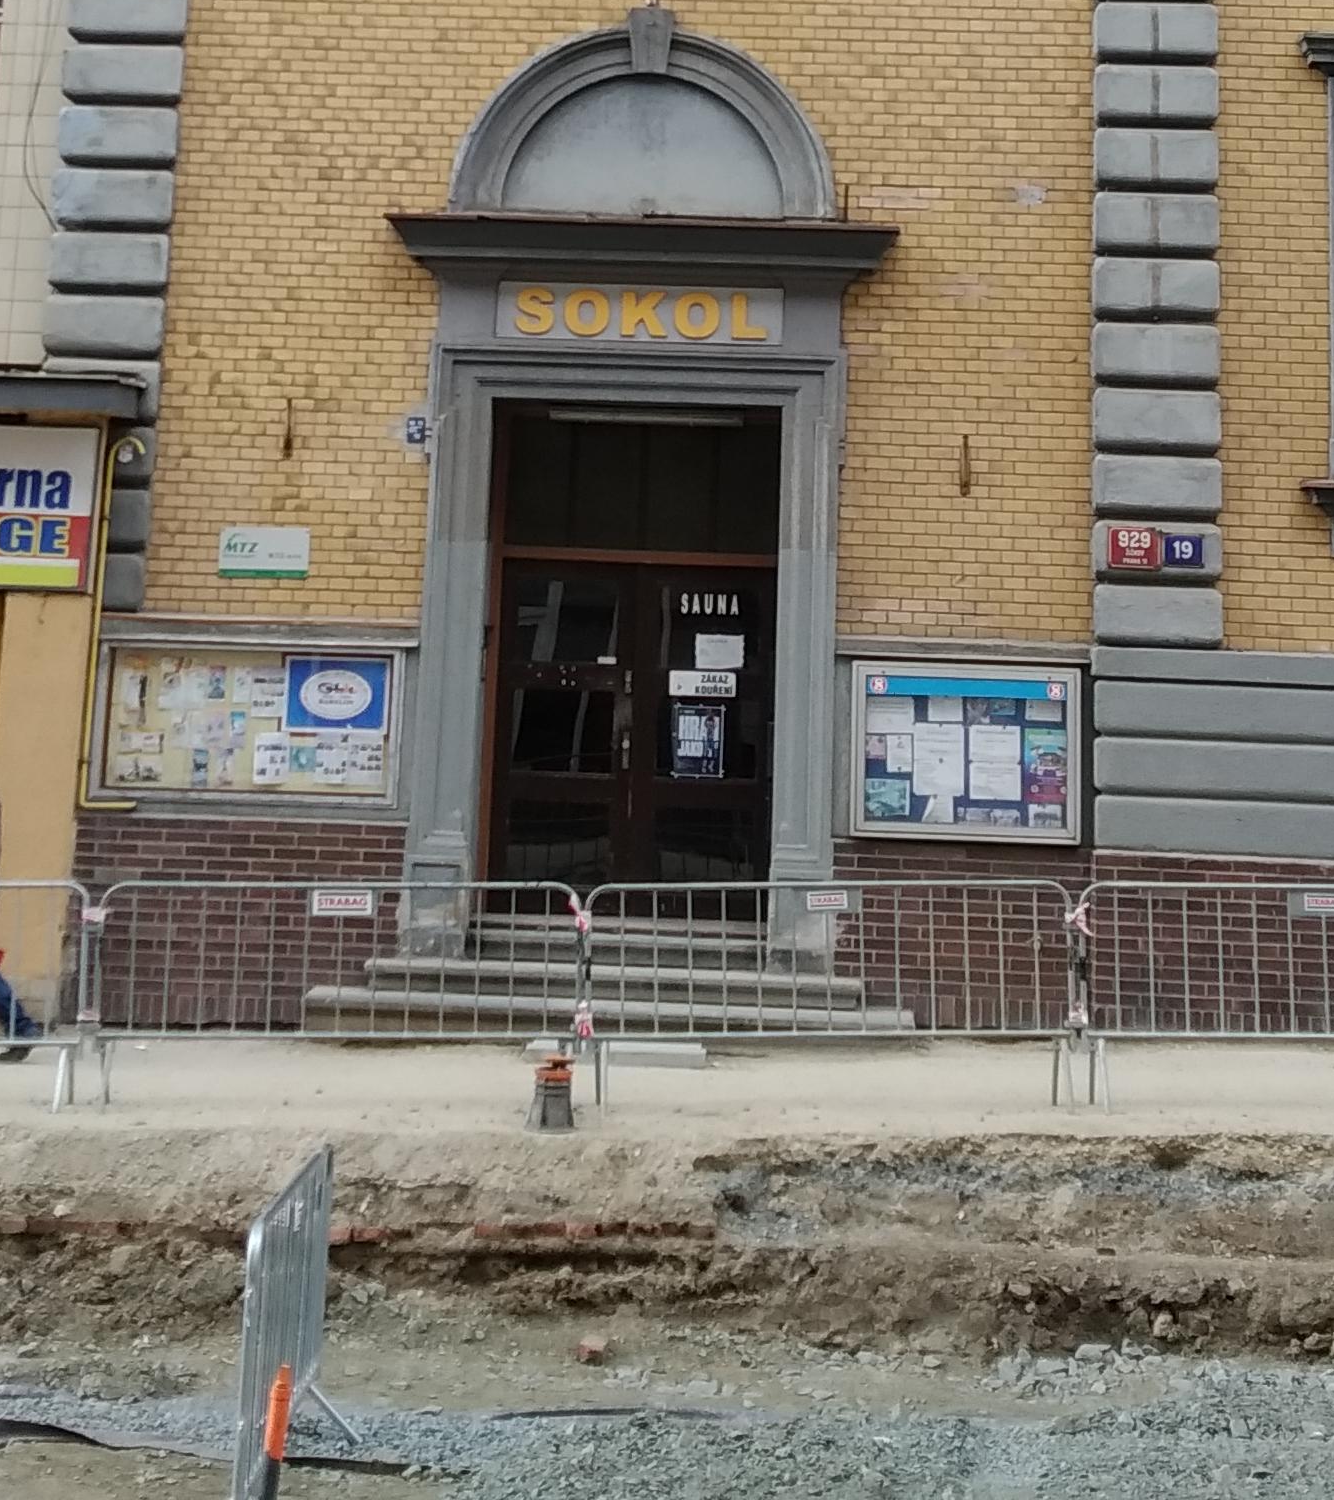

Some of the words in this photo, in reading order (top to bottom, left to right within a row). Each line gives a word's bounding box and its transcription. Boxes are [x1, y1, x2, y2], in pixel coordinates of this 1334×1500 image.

[515, 287, 767, 339] SOKOL
[224, 542, 259, 553] MTZ
[1118, 530, 1151, 549] 929
[1172, 540, 1193, 559] 19
[681, 593, 739, 615] SAUNA
[700, 673, 729, 684] ZÁKAZ
[695, 684, 733, 695] KOUŘENÍ
